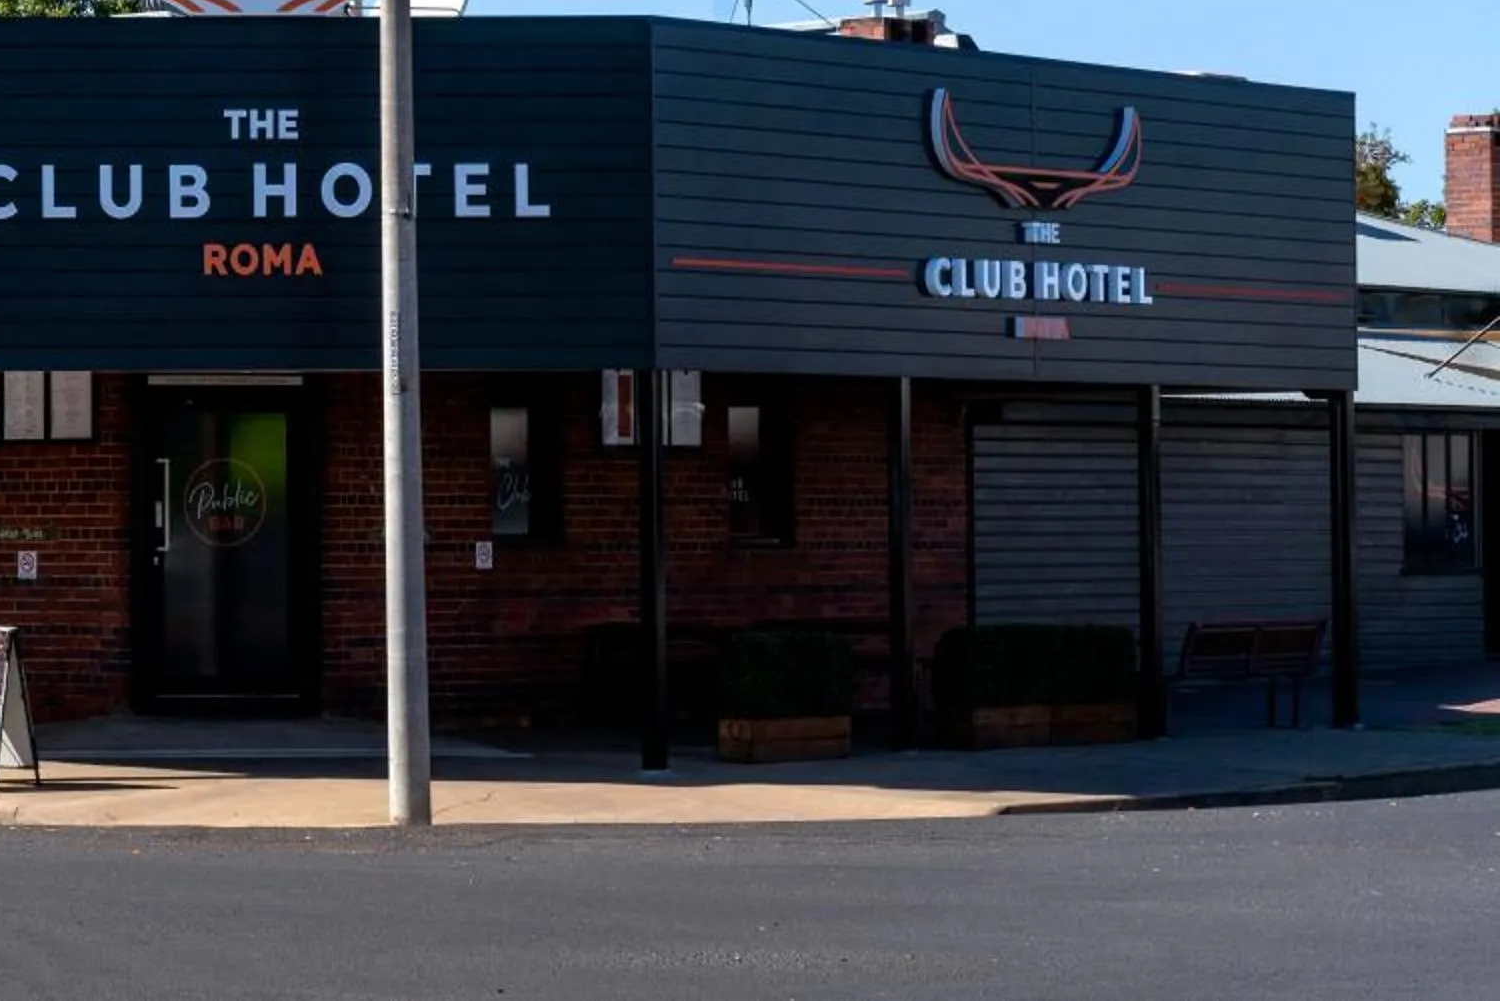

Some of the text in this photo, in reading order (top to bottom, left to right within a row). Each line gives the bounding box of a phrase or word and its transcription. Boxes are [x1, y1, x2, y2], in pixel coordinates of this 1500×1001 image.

[224, 109, 299, 140] THE
[1021, 221, 1060, 244] THE
[203, 243, 322, 276] ROMA
[925, 257, 1153, 304] CLUB HOTEL
[188, 476, 260, 520] Public
